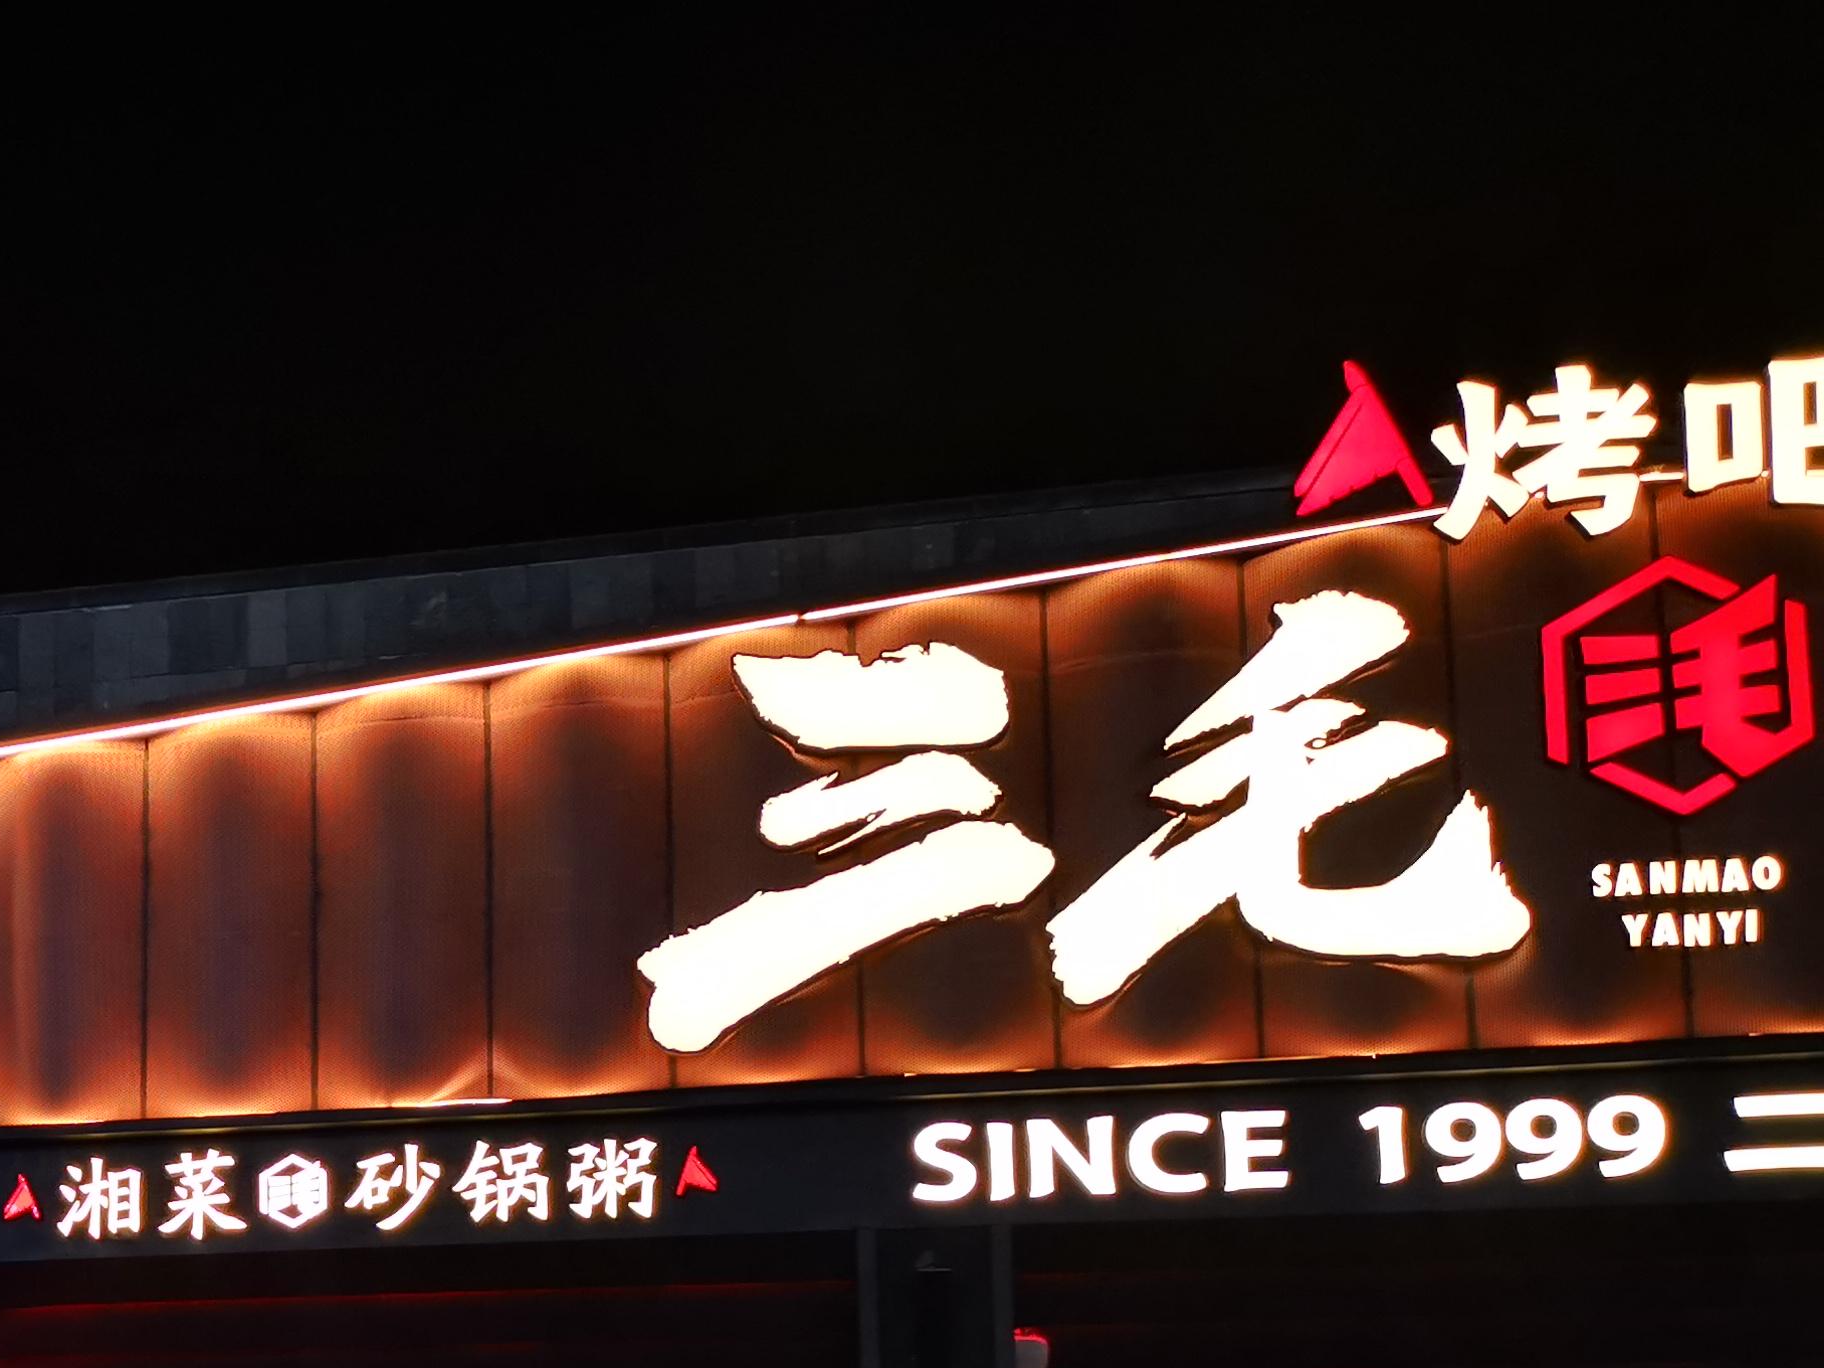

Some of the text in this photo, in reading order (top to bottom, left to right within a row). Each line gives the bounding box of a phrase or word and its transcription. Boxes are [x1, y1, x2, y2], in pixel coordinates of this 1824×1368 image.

[1431, 357, 1824, 540] 烤吧
[636, 589, 1531, 1054] 三毛
[1592, 855, 1782, 897] SANMAO
[1622, 909, 1759, 947] YANYI
[56, 1146, 248, 1240] 湘菜
[344, 1136, 659, 1231] 砂锅粥
[912, 1107, 1289, 1201] SINCE
[1359, 1094, 1668, 1184] 1999
